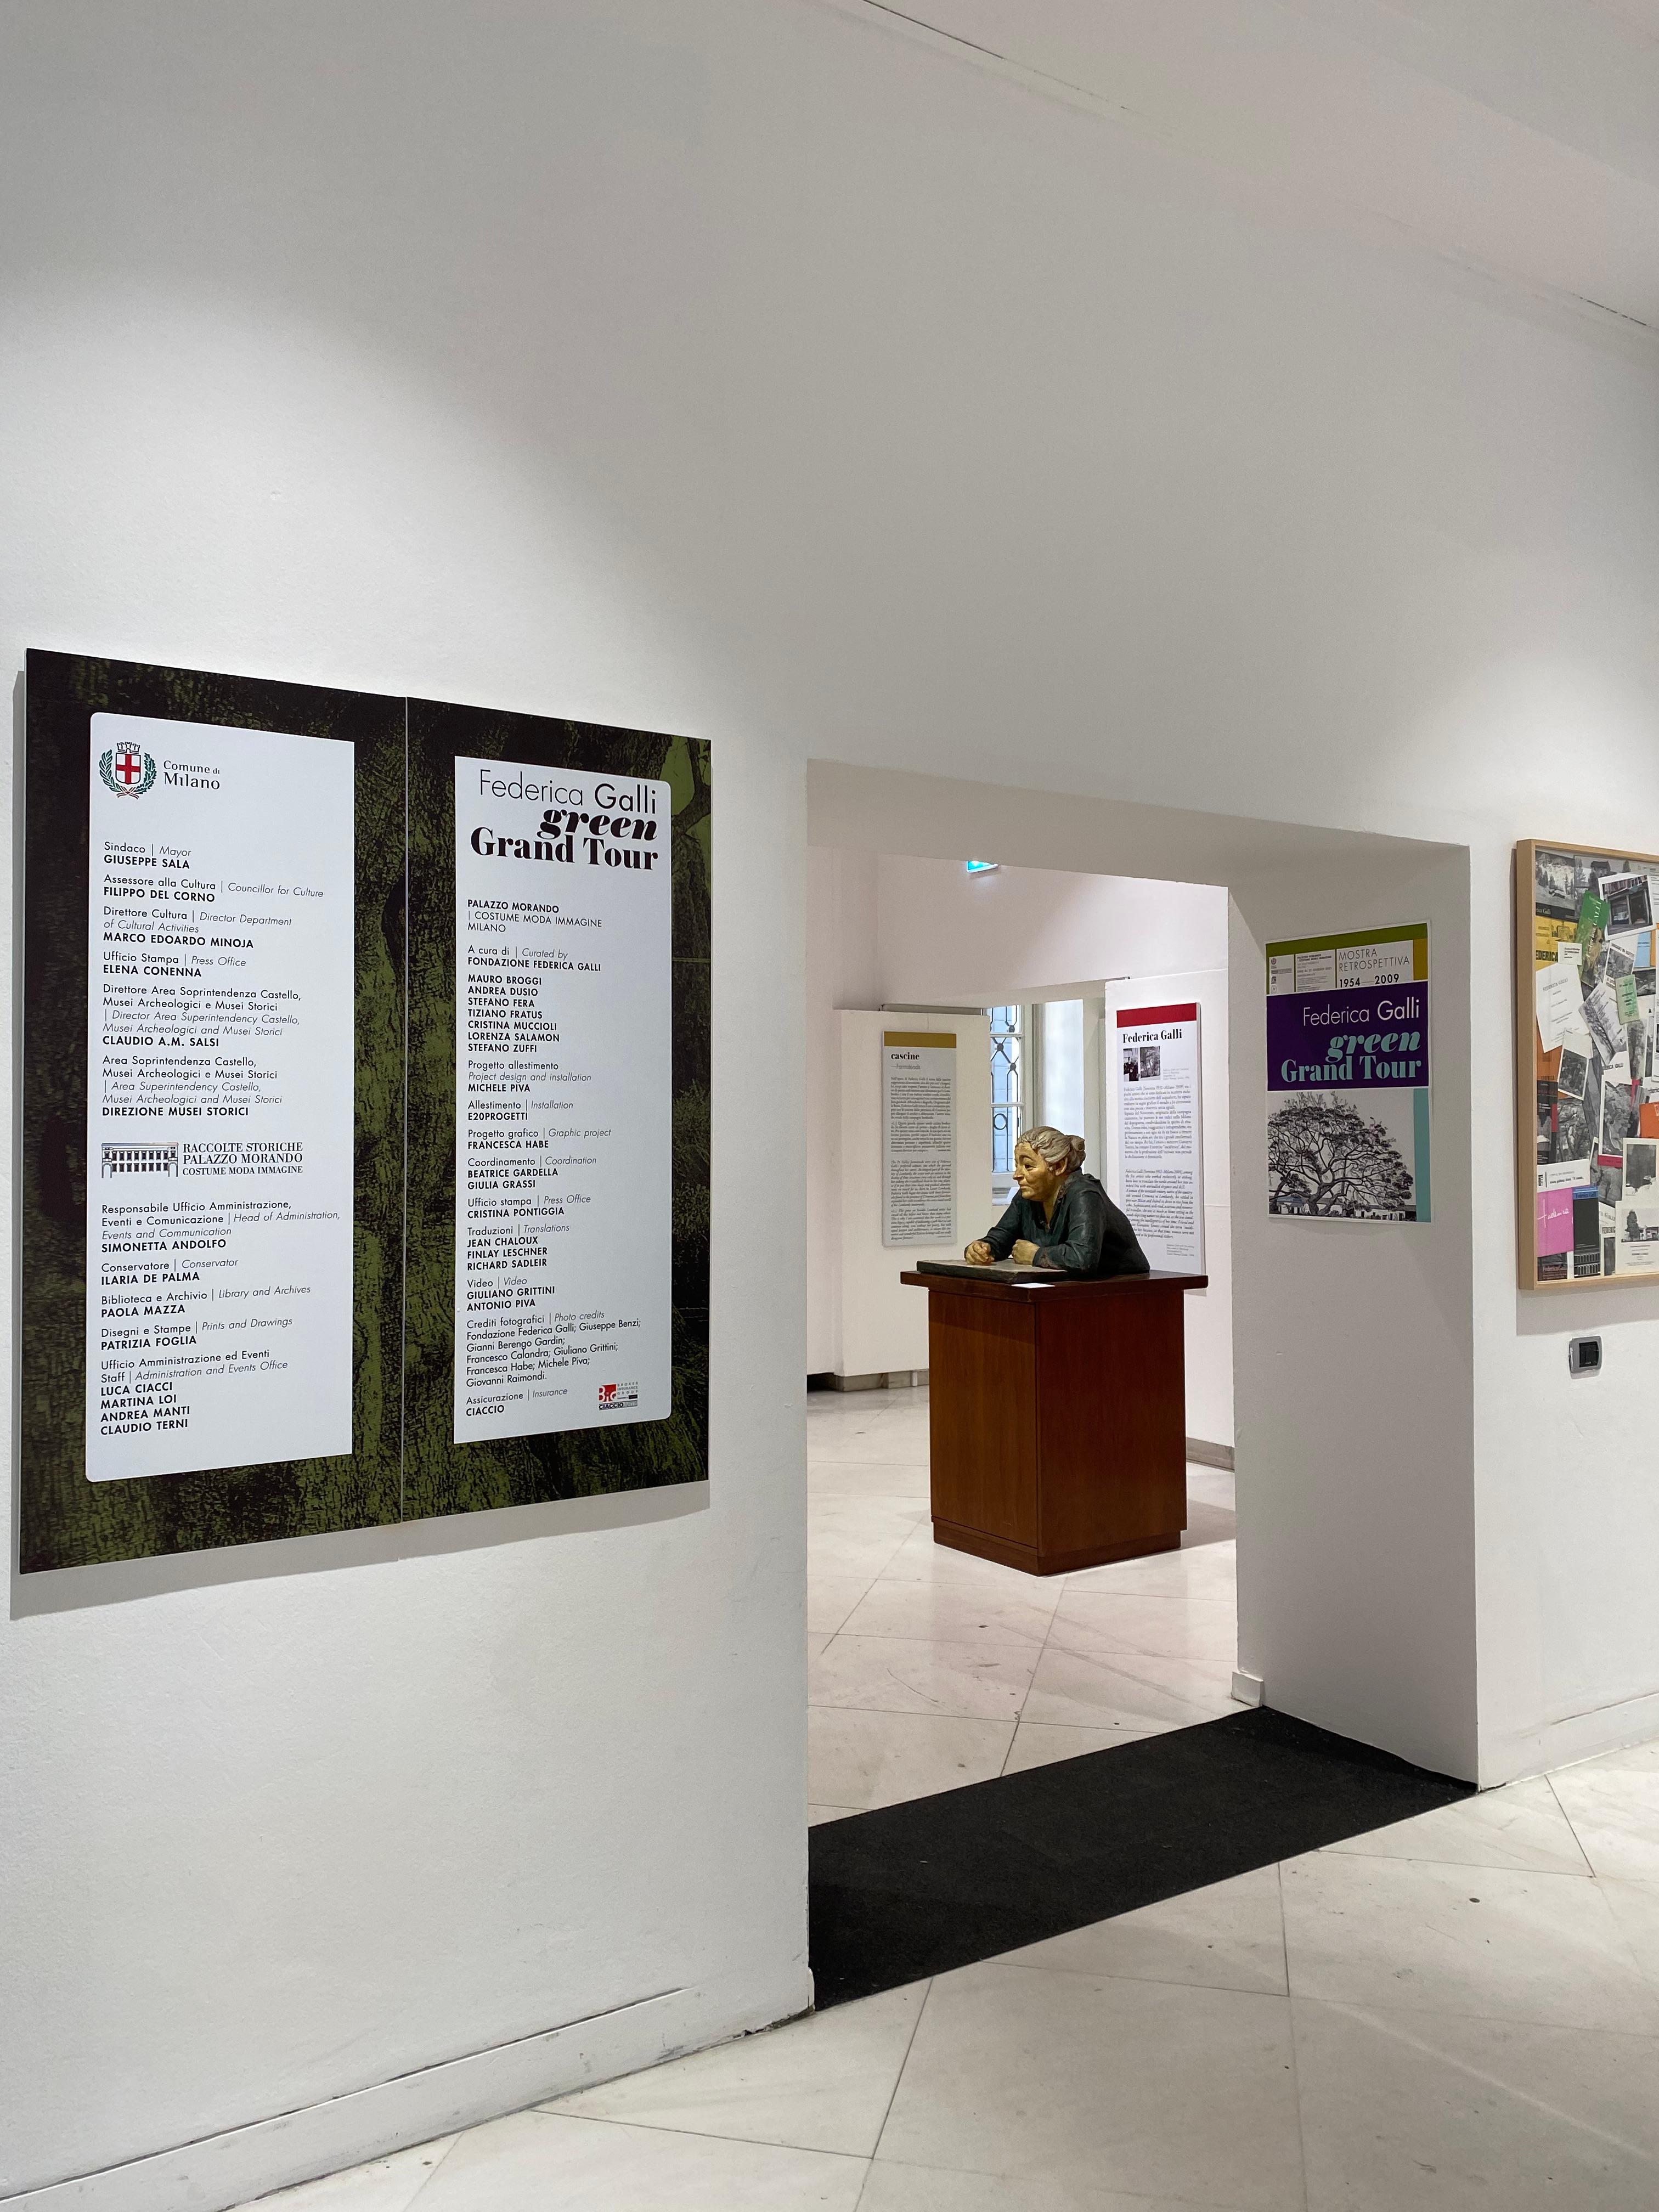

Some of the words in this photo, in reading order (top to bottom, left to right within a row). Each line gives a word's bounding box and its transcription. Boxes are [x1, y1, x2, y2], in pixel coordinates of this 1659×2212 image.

[163, 760, 211, 774] Comune
[163, 771, 220, 790] Milano
[480, 769, 583, 806] Federica
[594, 783, 656, 815] Galli
[537, 809, 657, 841] green
[104, 841, 145, 853] Sindaco
[159, 845, 192, 859] Mayor
[471, 827, 575, 863] Grand
[583, 838, 658, 870] Tour
[104, 854, 157, 867] GIUSEPPE
[162, 858, 190, 870] SALA
[103, 873, 154, 886] Assessore
[158, 877, 177, 887] alla
[180, 879, 216, 890] Cultura
[228, 882, 274, 894] Councillor
[278, 885, 290, 895] for
[293, 887, 324, 898] Culture
[104, 886, 145, 898] FILIPPO
[150, 889, 170, 900] DEL
[173, 891, 215, 902] CORNO
[467, 899, 509, 910] PALAZZO
[511, 902, 560, 913] MORANDO
[104, 906, 148, 917] Direttore
[151, 909, 187, 919] Cultura
[200, 911, 236, 922] Director
[239, 914, 292, 927] Department
[475, 911, 520, 922] COSTUME
[523, 914, 552, 924] MODA
[555, 916, 602, 928] IMMAGINE
[103, 918, 115, 928] of
[117, 919, 155, 930] Cultural
[157, 922, 199, 933] Activities
[467, 922, 506, 933] MILANO
[103, 932, 146, 943] MARCO
[151, 934, 206, 946] EDOARDO
[210, 937, 253, 949] MINOJA
[467, 944, 475, 954] A
[501, 946, 510, 956] di
[522, 947, 555, 958] Curated
[557, 949, 568, 961] by
[1339, 948, 1377, 961] MOSTRA
[1536, 950, 1558, 963] EDERICA
[103, 964, 139, 975] ELENA
[143, 966, 202, 977] CONENNA
[468, 957, 529, 968] FONDAZIONE
[533, 960, 574, 970] FEDERICA
[577, 962, 601, 972] GALLI
[1339, 956, 1410, 972] RETROSPETTIVA
[467, 974, 503, 984] MAURO
[506, 975, 541, 985] BROGGI
[1339, 978, 1361, 988] 1954
[1374, 973, 1400, 985] 2009
[467, 985, 506, 995] ANDREA
[510, 987, 538, 997] DUSIO
[1303, 1003, 1370, 1026] Federica
[1377, 996, 1420, 1021] Galli
[467, 1020, 510, 1030] CRISTINA
[514, 1021, 557, 1031] MUCCIOLI
[102, 1035, 154, 1046] CLAUDIO
[157, 1036, 184, 1046] A.M.
[189, 1037, 219, 1047] SALSI
[1122, 1031, 1159, 1043] Federica
[1160, 1029, 1182, 1040] Galli
[1325, 1031, 1421, 1063] green
[891, 1052, 920, 1060] cascine
[1281, 1056, 1353, 1083] Grand
[1359, 1055, 1422, 1080] Tour
[467, 1083, 506, 1092] MICHELE
[510, 1084, 531, 1092] PIVA
[102, 1107, 163, 1116] DIREZIONE
[168, 1107, 202, 1116] MUSEI
[206, 1107, 249, 1116] STORICI
[468, 1112, 528, 1121] E20PROGETTI
[468, 1129, 505, 1141] Progetto
[508, 1127, 539, 1140] grafico
[548, 1127, 581, 1139] Graphic
[584, 1129, 611, 1139] project
[182, 1143, 243, 1153] RACCOLTE
[246, 1142, 303, 1152] STORICHE
[468, 1140, 522, 1149] FRANCESCA
[526, 1140, 549, 1149] HABE
[183, 1154, 238, 1165] PALAZZO
[240, 1153, 303, 1164] MORANDO
[182, 1167, 227, 1176] COSTUME
[228, 1166, 255, 1175] MODA
[257, 1165, 303, 1174] IMMAGINE
[467, 1169, 510, 1178] BEATRICE
[513, 1167, 558, 1177] GARDELLA
[102, 1202, 168, 1216] Responsabile
[173, 1201, 205, 1212] Ufficio
[209, 1200, 291, 1211] Amministrazione,
[467, 1209, 510, 1219] CRISTINA
[514, 1206, 565, 1217] PONTIGGIA
[101, 1241, 167, 1253] SIMONETTA
[171, 1239, 227, 1250] ANDOLFO
[467, 1238, 491, 1248] JEAN
[494, 1236, 538, 1246] CHALOUX
[101, 1262, 170, 1273] Conservatore
[182, 1259, 239, 1269] Conservator
[101, 1274, 139, 1285] ILARIA
[143, 1273, 157, 1283] DE
[162, 1271, 200, 1283] PALMA
[466, 1278, 493, 1288] Video
[504, 1276, 527, 1285] Video
[101, 1307, 139, 1318] PAOLA
[143, 1304, 185, 1316] MAZZA
[466, 1318, 496, 1329] Crediti
[500, 1314, 545, 1328] fotografici
[554, 1312, 577, 1322] Photo
[579, 1310, 605, 1320] credits
[467, 1329, 516, 1341] Fondazione
[518, 1325, 552, 1336] Federica
[555, 1322, 577, 1334] Galli;
[579, 1322, 616, 1332] Giuseppe
[618, 1318, 641, 1328] Benzi;
[101, 1338, 151, 1351] PATRIZIA
[156, 1335, 197, 1347] FOGLIA
[466, 1341, 495, 1352] Gianni
[498, 1341, 532, 1350] Berengo
[535, 1335, 565, 1346] Gardin;
[101, 1385, 131, 1396] LUCA
[135, 1381, 172, 1393] CIACCI
[100, 1396, 154, 1409] MARTINA
[159, 1394, 177, 1404] LOI
[466, 1392, 523, 1405] Assicurazione
[532, 1389, 568, 1398] Insurance
[100, 1409, 149, 1423] ANDREA
[153, 1406, 190, 1418] MANTI
[466, 1404, 505, 1417] CIACCIO
[100, 1422, 152, 1435] CLAUDIO
[156, 1418, 188, 1430] TERNI
